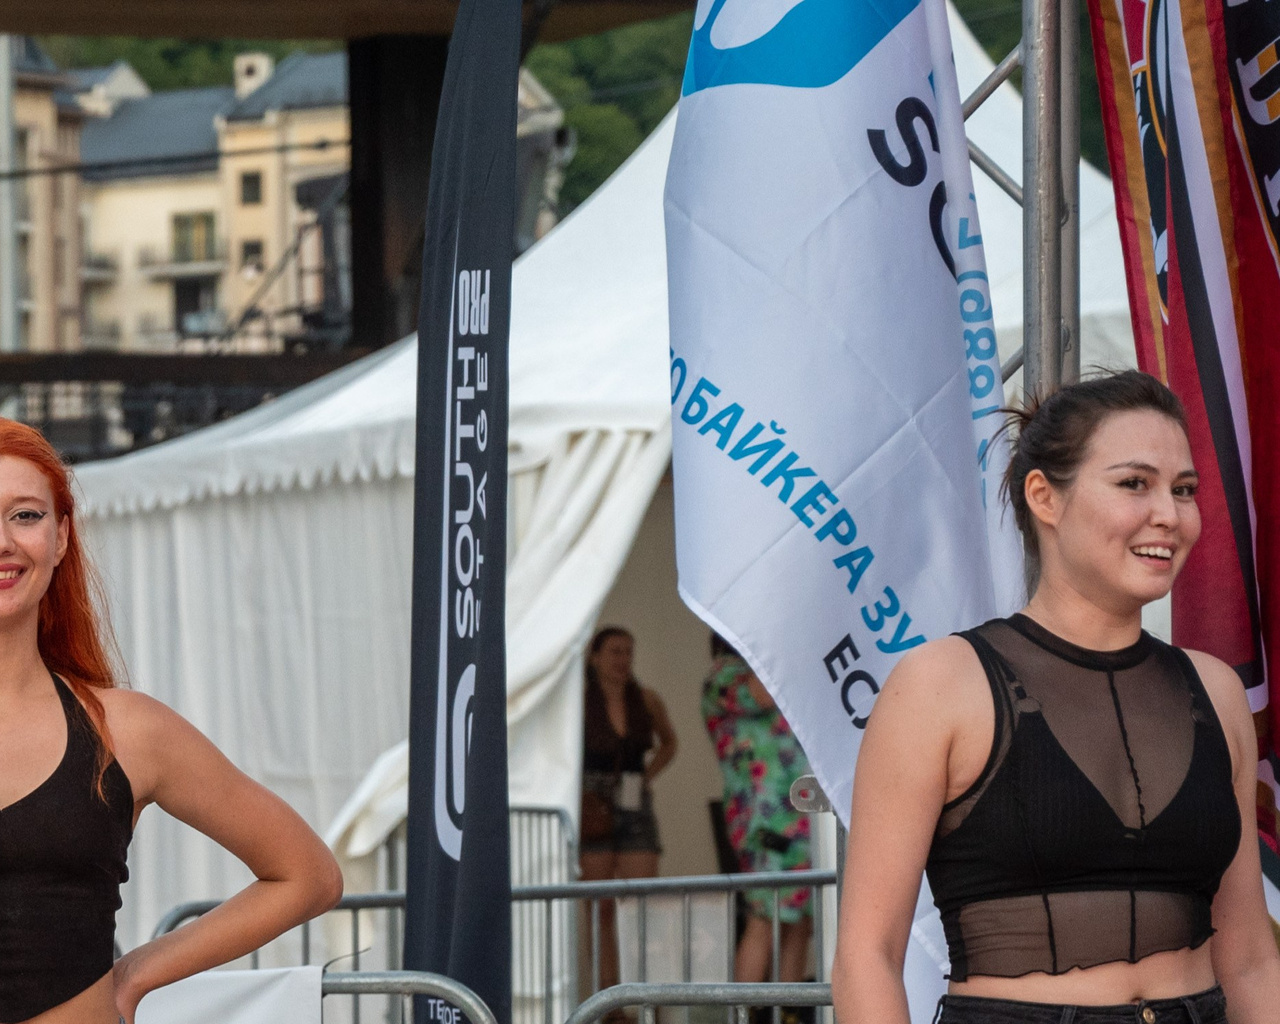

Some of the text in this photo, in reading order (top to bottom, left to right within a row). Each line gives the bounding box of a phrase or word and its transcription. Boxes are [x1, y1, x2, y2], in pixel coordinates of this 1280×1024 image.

[458, 269, 490, 335] PRO
[455, 346, 476, 639] SOUTH
[670, 346, 875, 595] ОБАЙКЕРА
